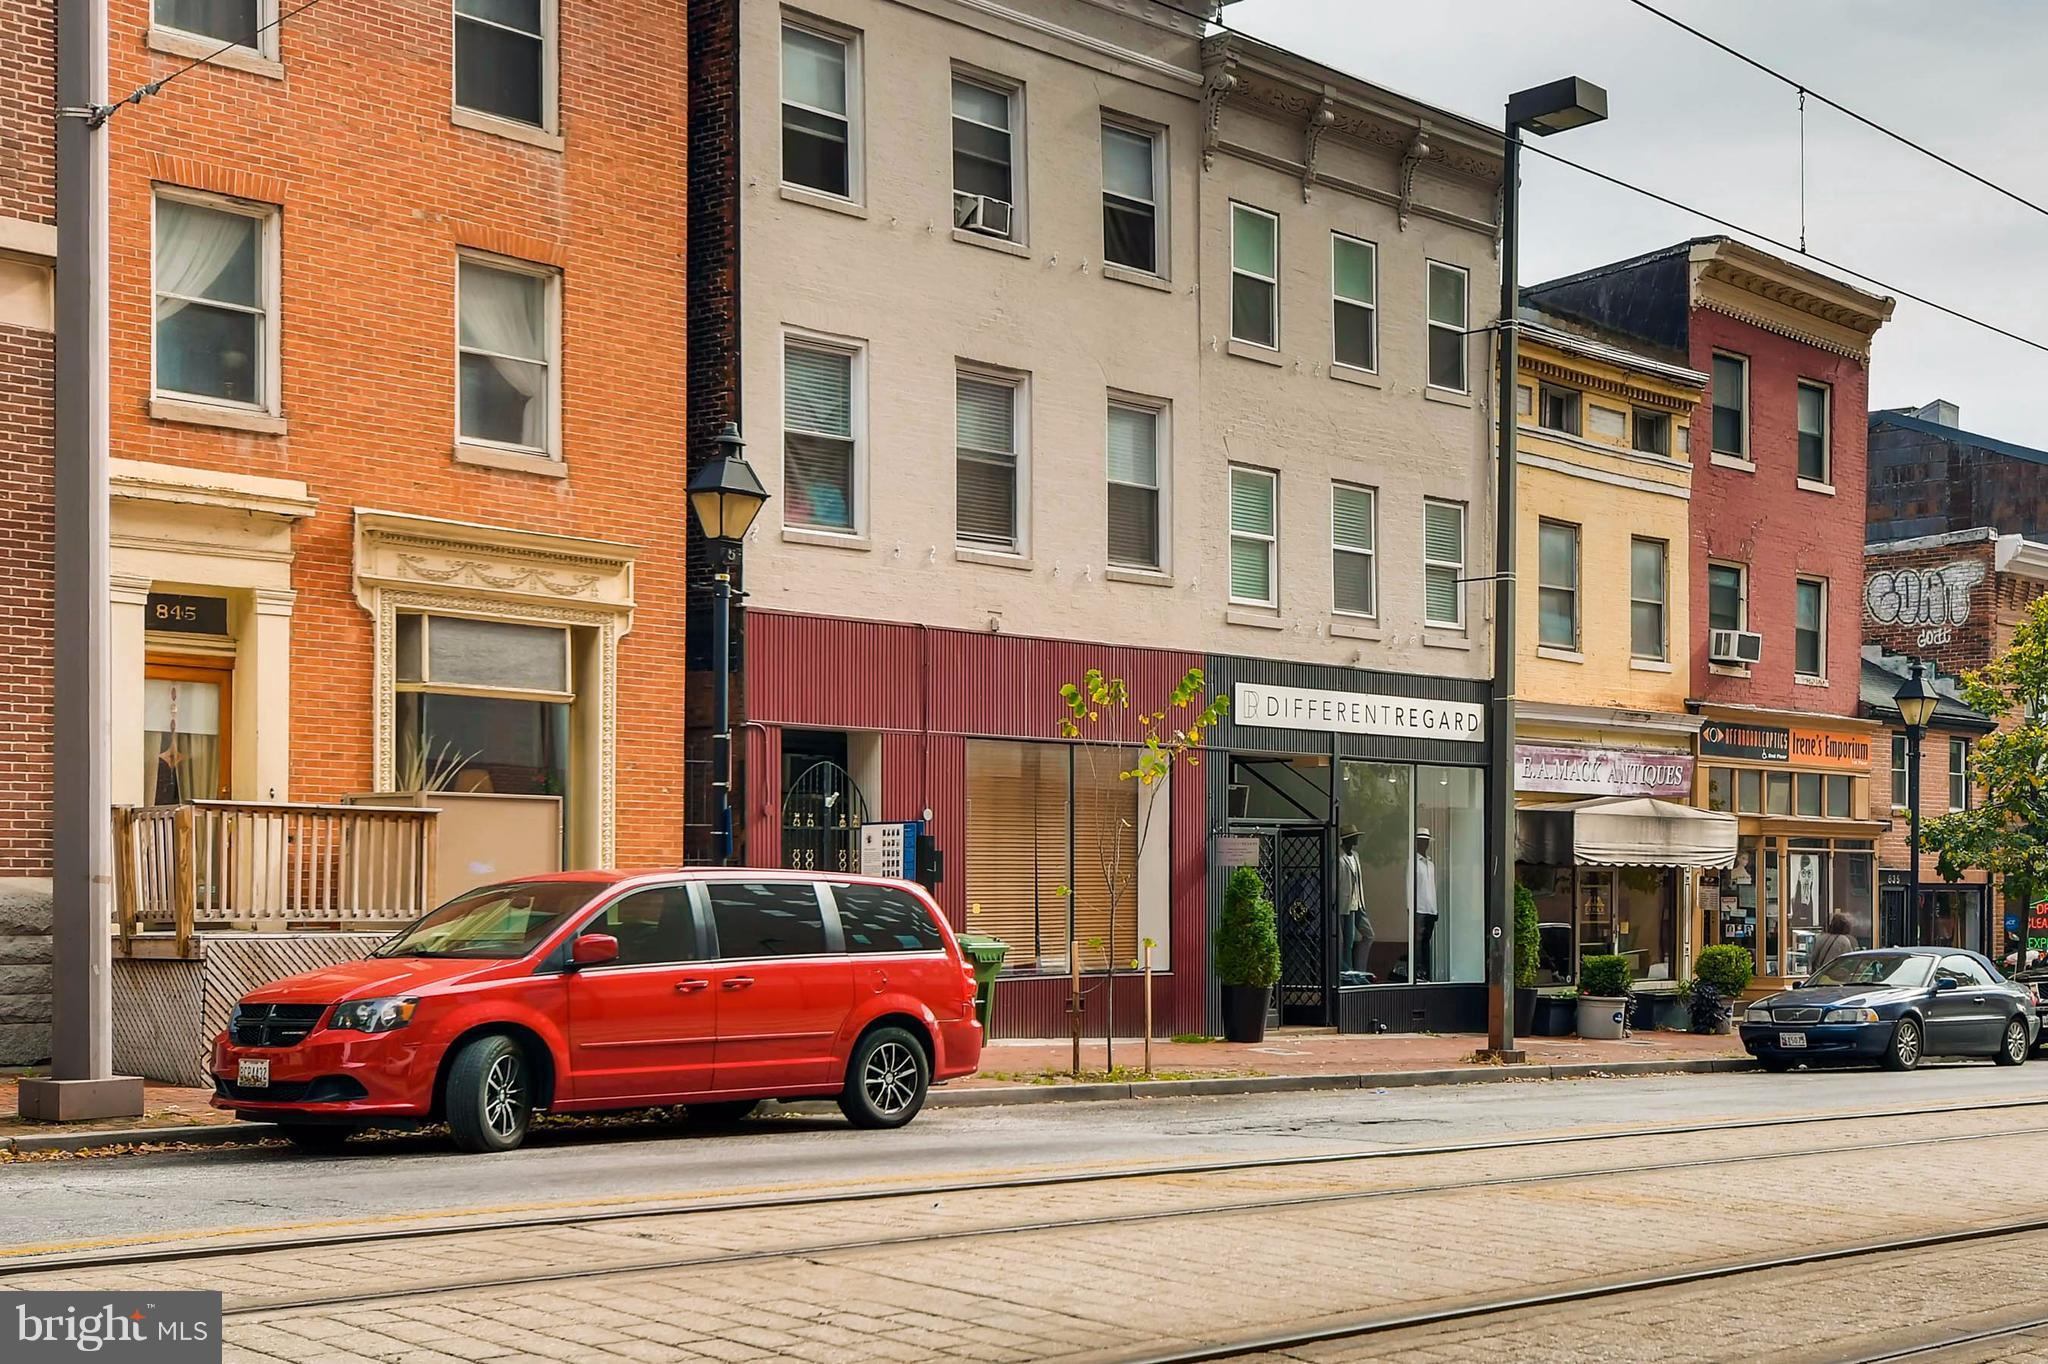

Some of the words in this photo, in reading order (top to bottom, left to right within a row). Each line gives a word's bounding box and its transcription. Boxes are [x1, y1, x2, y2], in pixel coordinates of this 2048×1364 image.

[156, 603, 197, 621] 845
[1267, 696, 1479, 733] DIFFERENTREGARD
[1792, 731, 1822, 757] Irene's
[1825, 735, 1869, 761] Emporium
[1607, 760, 1684, 788] ANTIQUES
[2028, 937, 2048, 949] EXP
